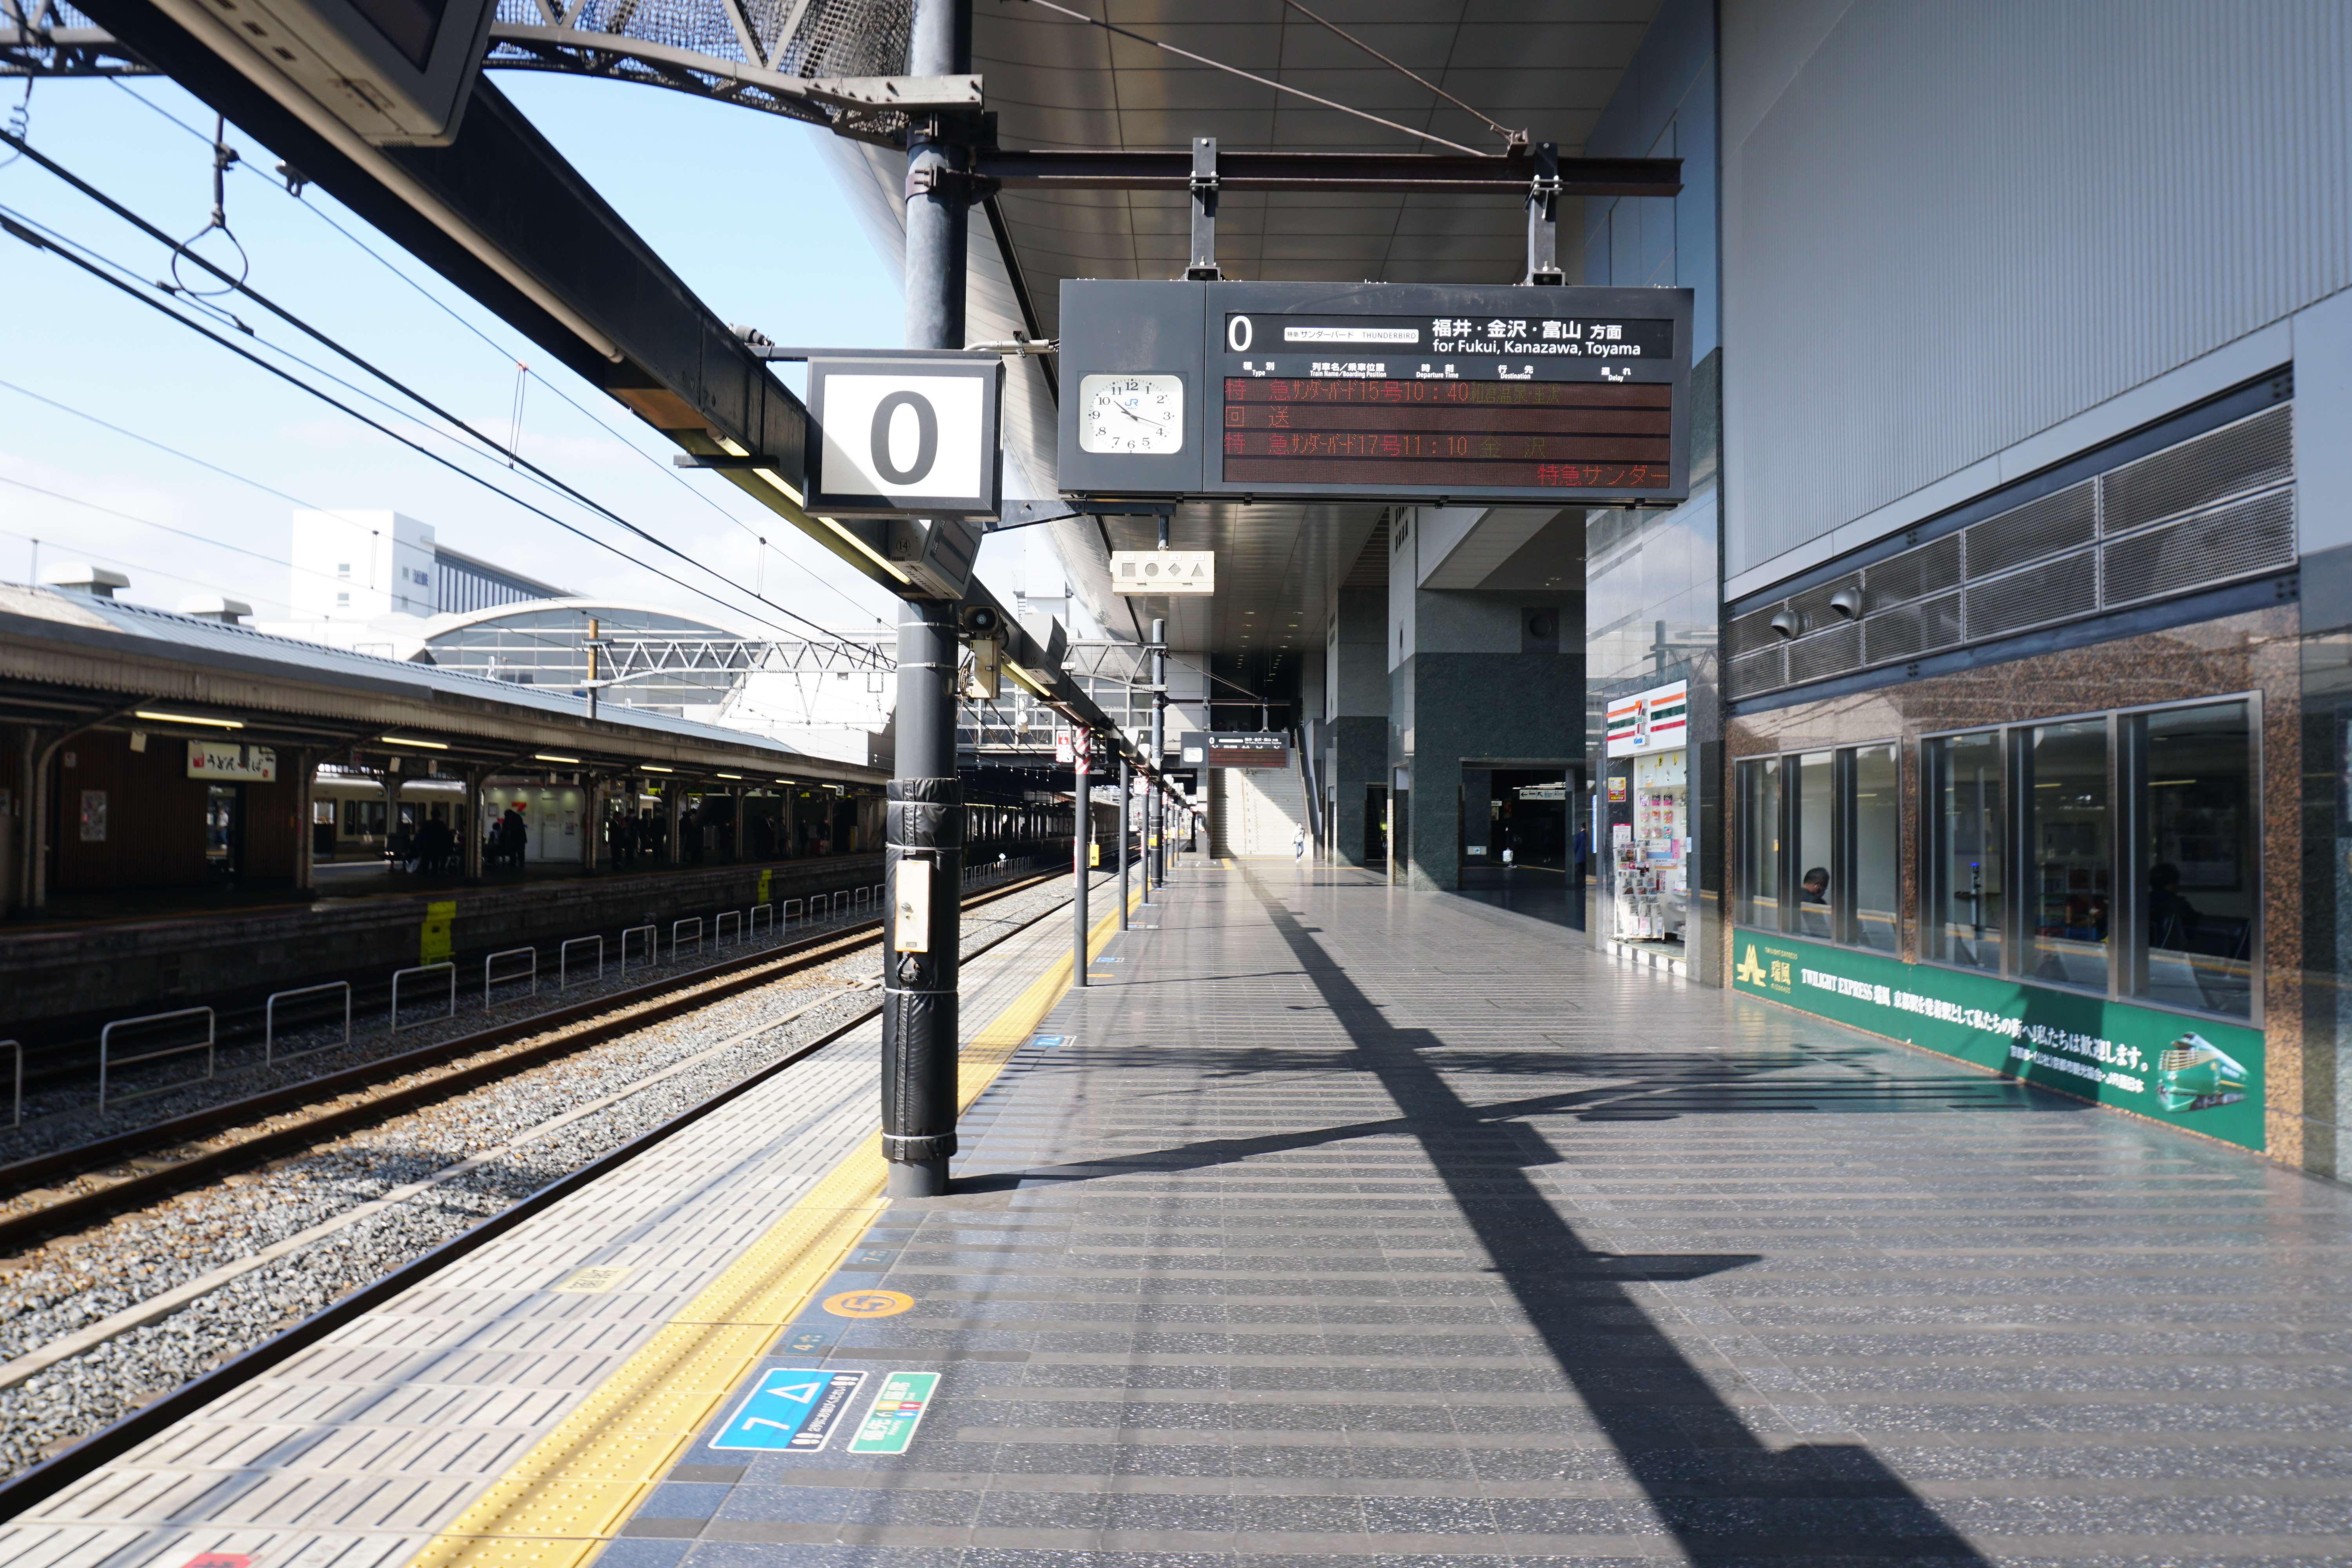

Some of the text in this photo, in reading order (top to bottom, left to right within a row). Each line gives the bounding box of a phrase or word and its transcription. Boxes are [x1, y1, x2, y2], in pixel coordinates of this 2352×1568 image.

[1229, 316, 1252, 351] 0
[1432, 319, 1622, 340] 福井・金沢・富山 方面
[1301, 330, 1354, 339] サンダーバード
[1363, 332, 1416, 340] THUNDERBIRD
[1433, 339, 1641, 358] for Fukui, Kanazawa, Toyama
[1126, 382, 1138, 390] 12
[1145, 386, 1150, 394] 1
[1111, 387, 1122, 395] 11
[1098, 397, 1110, 405] 10
[1157, 395, 1165, 403] 2
[1092, 410, 1100, 419] 9
[1163, 412, 1171, 420] 3
[1098, 426, 1106, 435] 8
[870, 390, 938, 485] 0
[1112, 437, 1120, 445] 7
[1142, 437, 1150, 446] 5
[1127, 440, 1135, 449] 6
[899, 541, 909, 550] 14
[1801, 968, 1837, 991] TWILIGHT
[1838, 977, 1873, 1001] EXPRESS
